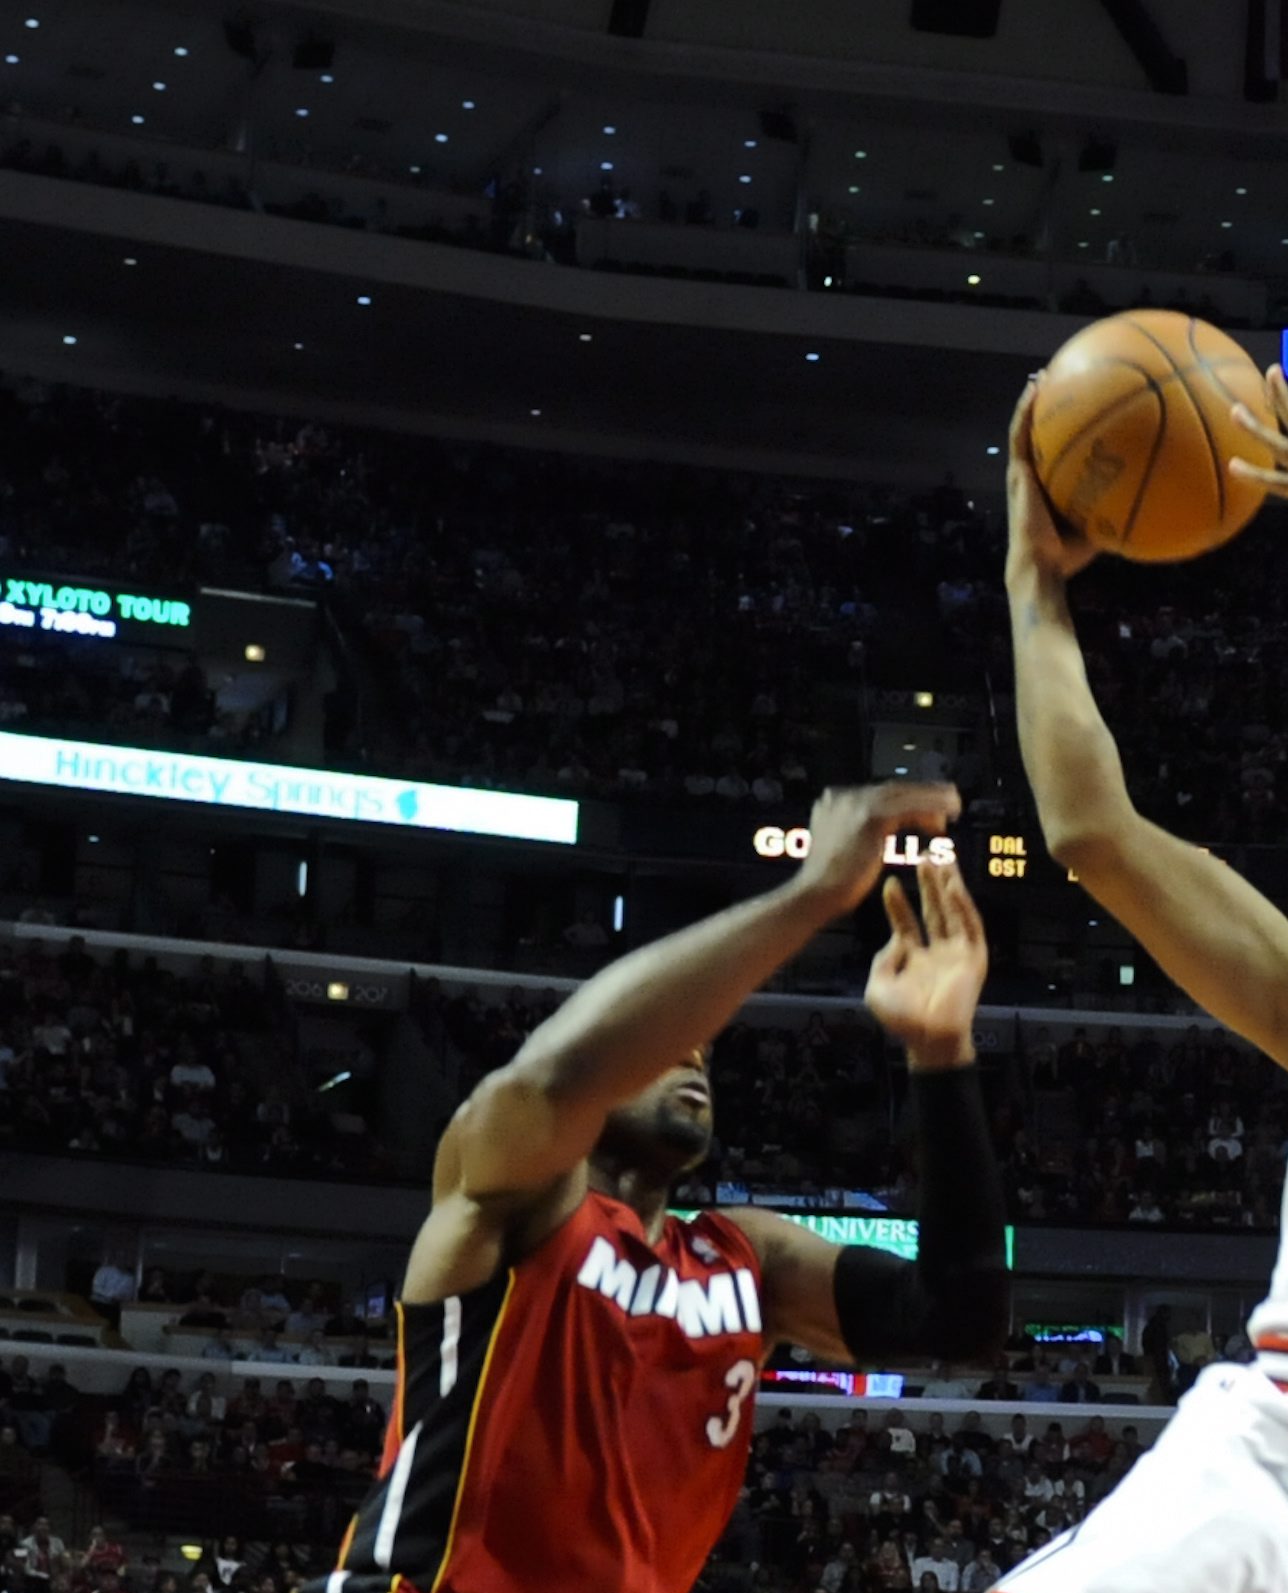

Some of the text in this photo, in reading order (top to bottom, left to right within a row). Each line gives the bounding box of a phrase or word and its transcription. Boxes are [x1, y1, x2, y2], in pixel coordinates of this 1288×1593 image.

[5, 578, 112, 616] XYLOTO
[117, 593, 191, 627] TOUR
[56, 749, 385, 818] Hinckley Springs
[753, 826, 812, 858] GO
[988, 835, 1027, 855] DAL
[988, 857, 1027, 877] GST
[705, 1359, 755, 1448] 3
